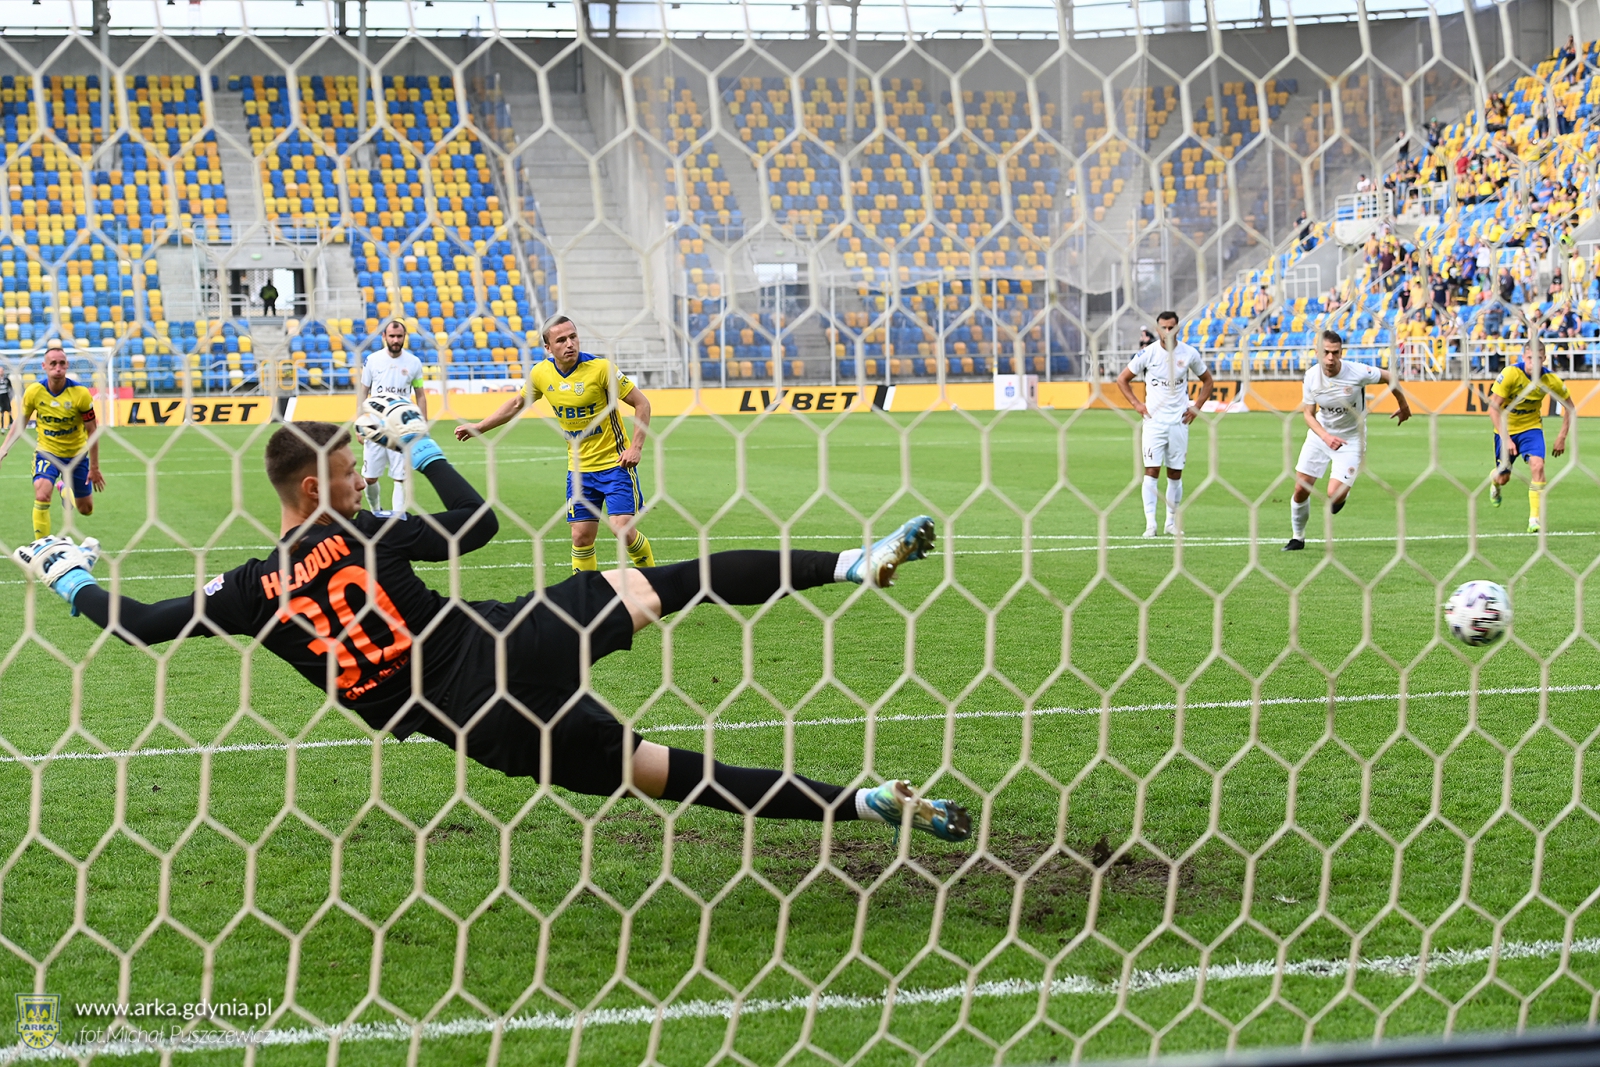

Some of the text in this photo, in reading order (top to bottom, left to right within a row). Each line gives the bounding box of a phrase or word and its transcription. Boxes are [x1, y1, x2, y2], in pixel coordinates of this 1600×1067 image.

[127, 401, 259, 424] LVBET
[37, 460, 51, 473] 17
[275, 565, 413, 689] 30
